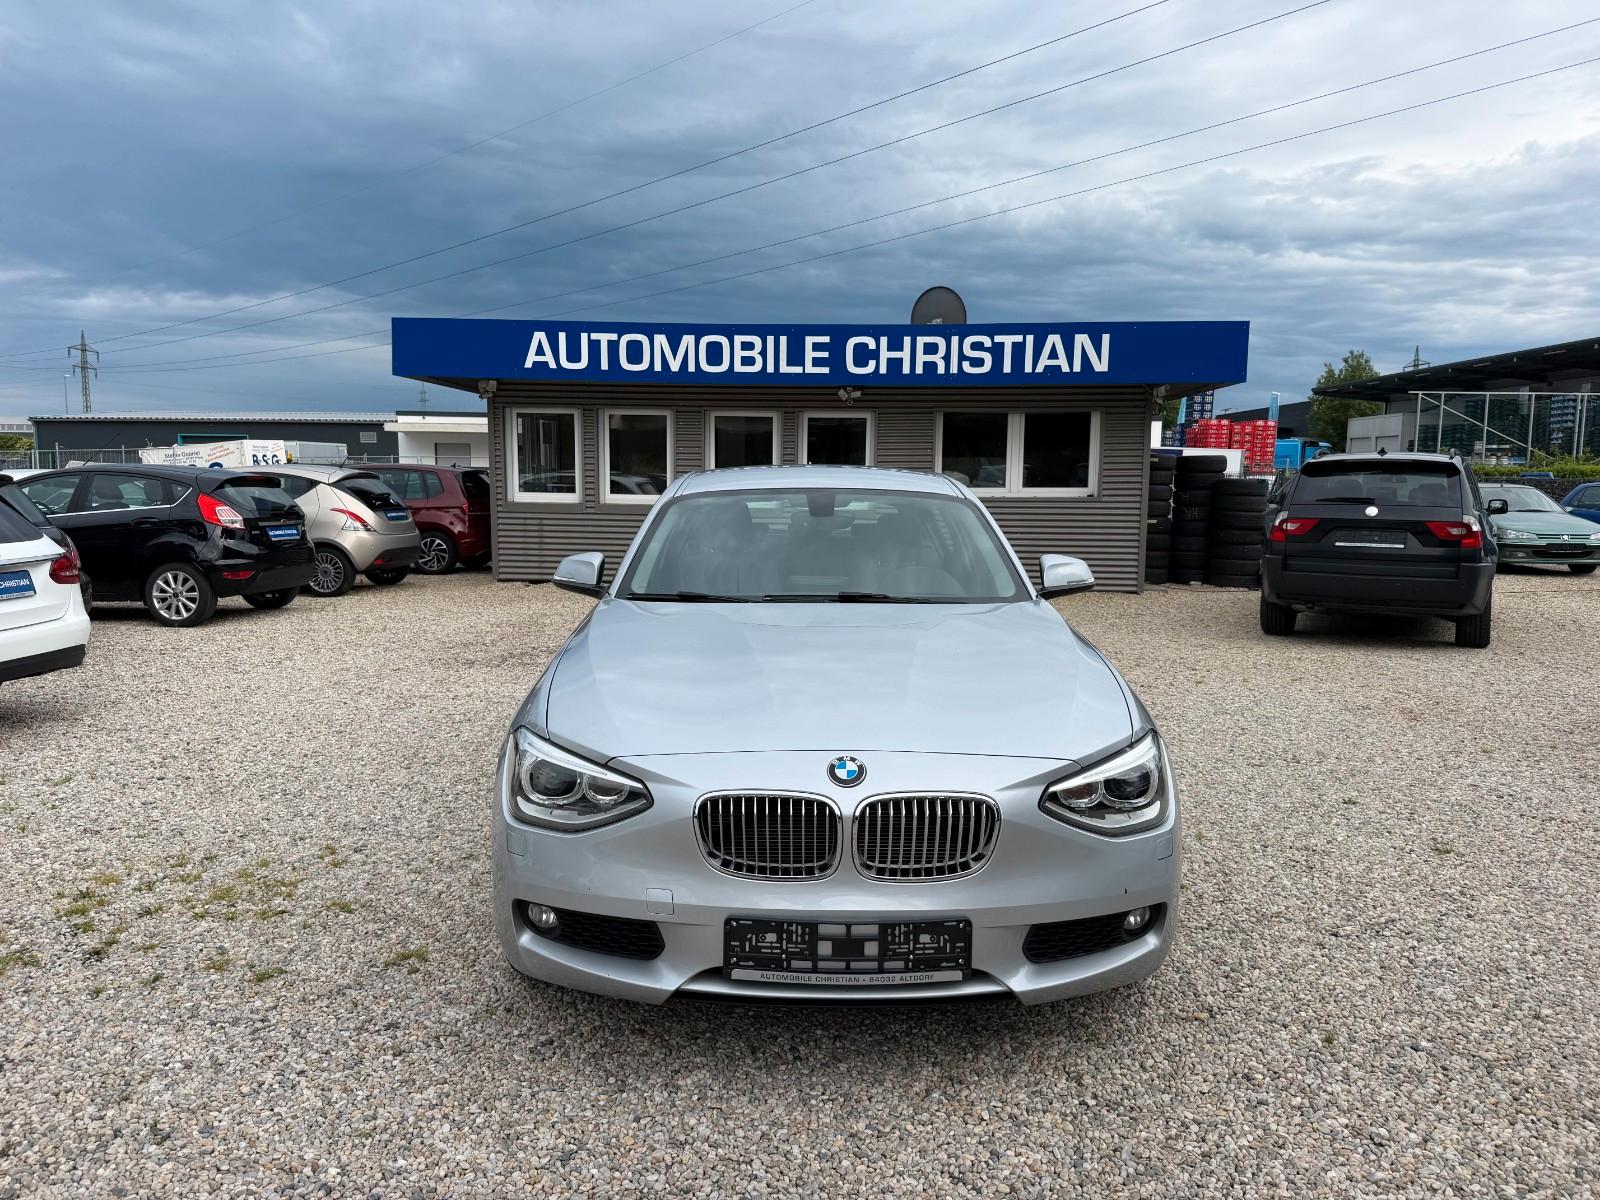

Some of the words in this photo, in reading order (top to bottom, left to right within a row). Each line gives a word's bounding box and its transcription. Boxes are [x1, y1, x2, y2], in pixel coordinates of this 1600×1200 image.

[523, 331, 830, 374] AUTOMOBILE
[844, 333, 1111, 375] CHRISTIAN
[760, 973, 813, 982] AUTOMOBILE
[815, 975, 860, 984] CHRISTIAN
